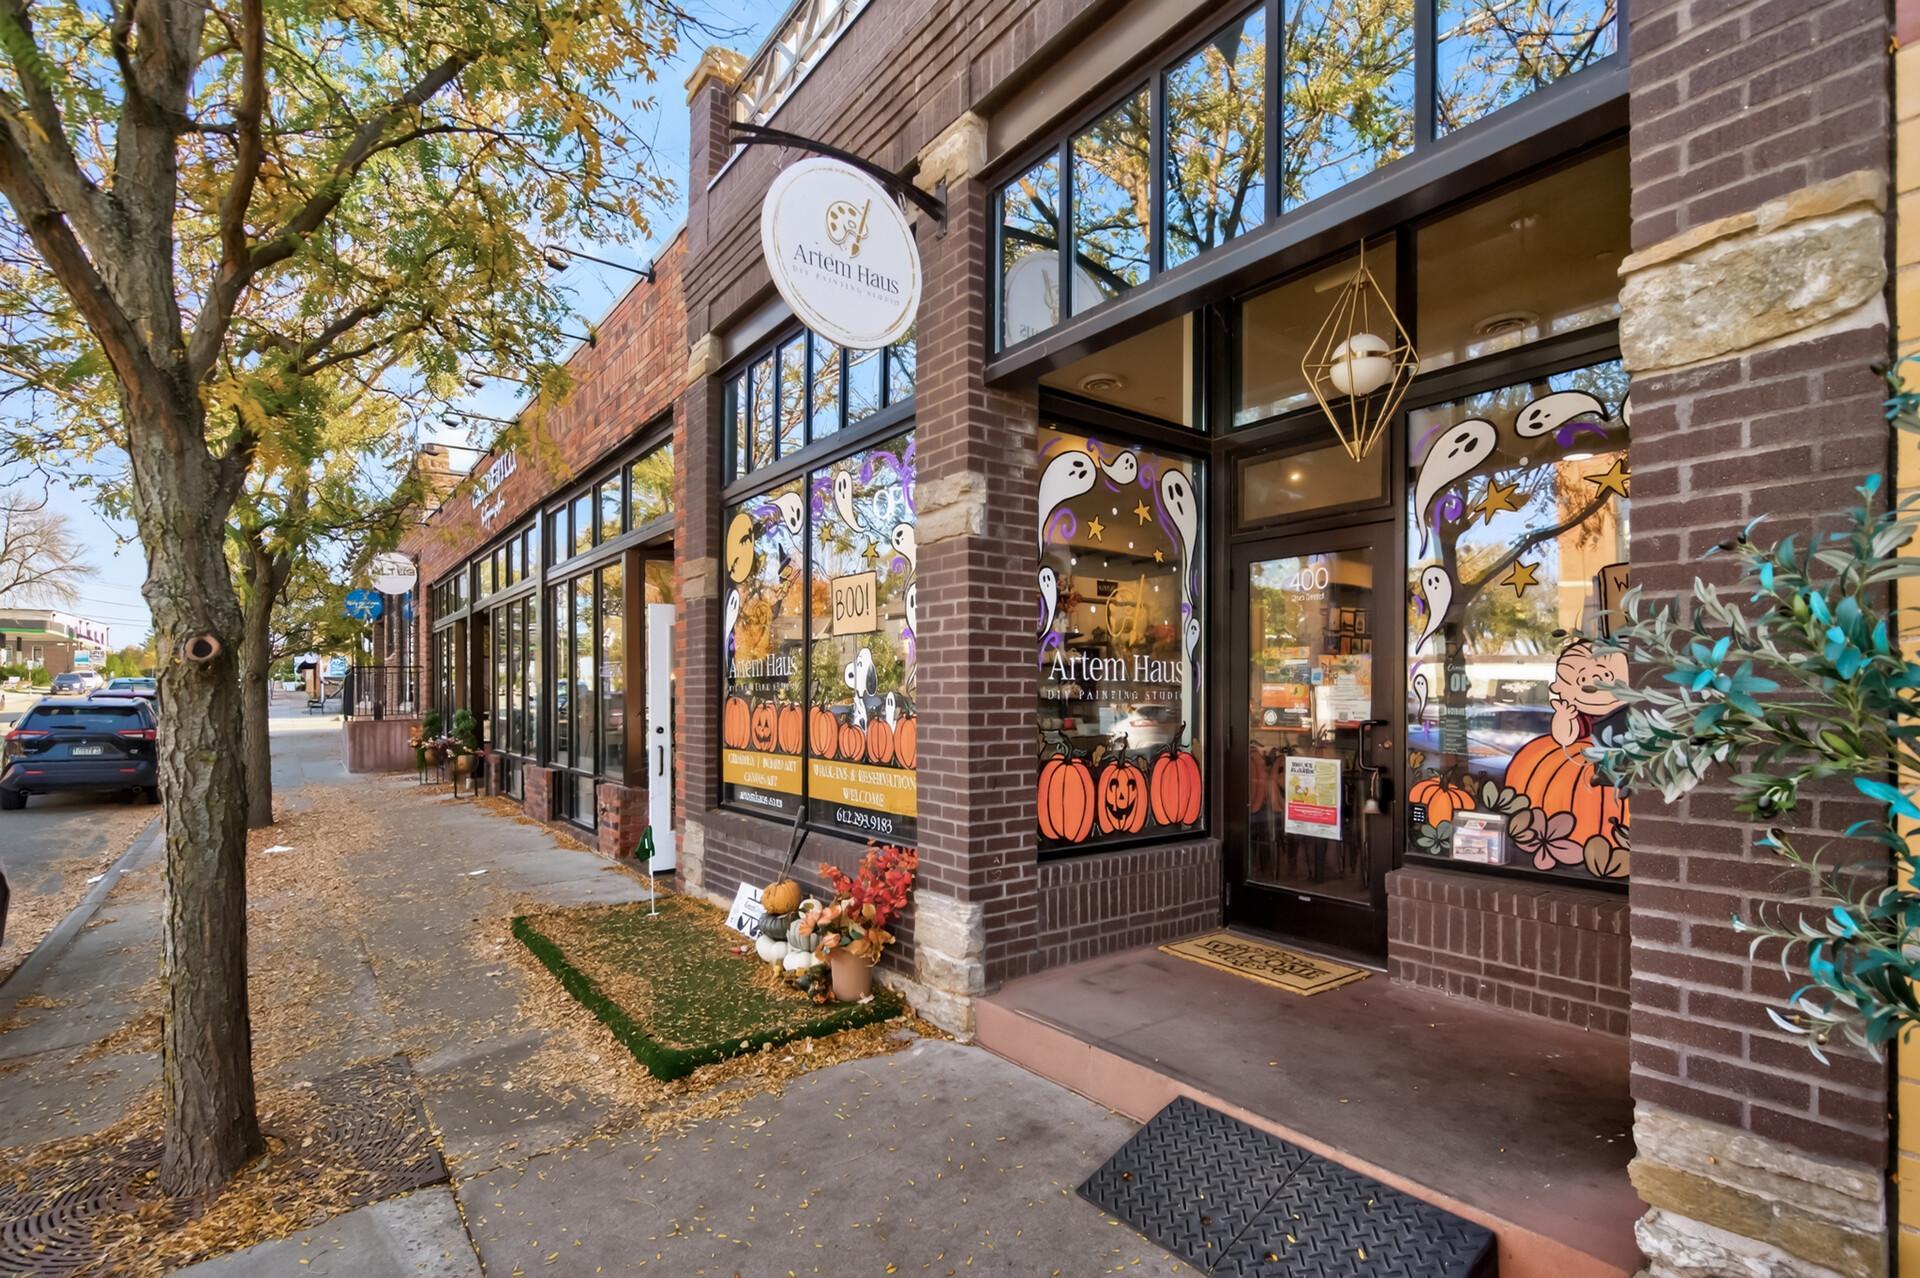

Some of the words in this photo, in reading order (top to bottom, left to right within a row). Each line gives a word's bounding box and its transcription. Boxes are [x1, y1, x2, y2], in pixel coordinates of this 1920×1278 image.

[793, 243, 852, 280] Artem
[857, 263, 900, 295] Haus
[1290, 567, 1329, 592] 400
[835, 582, 870, 621] BOO!
[766, 653, 798, 677] Haus
[1048, 650, 1126, 682] Artem
[1133, 654, 1183, 684] Haus
[1047, 689, 1071, 702] DIY
[1079, 690, 1138, 701] PAINTING
[843, 787, 885, 807] WELCOME
